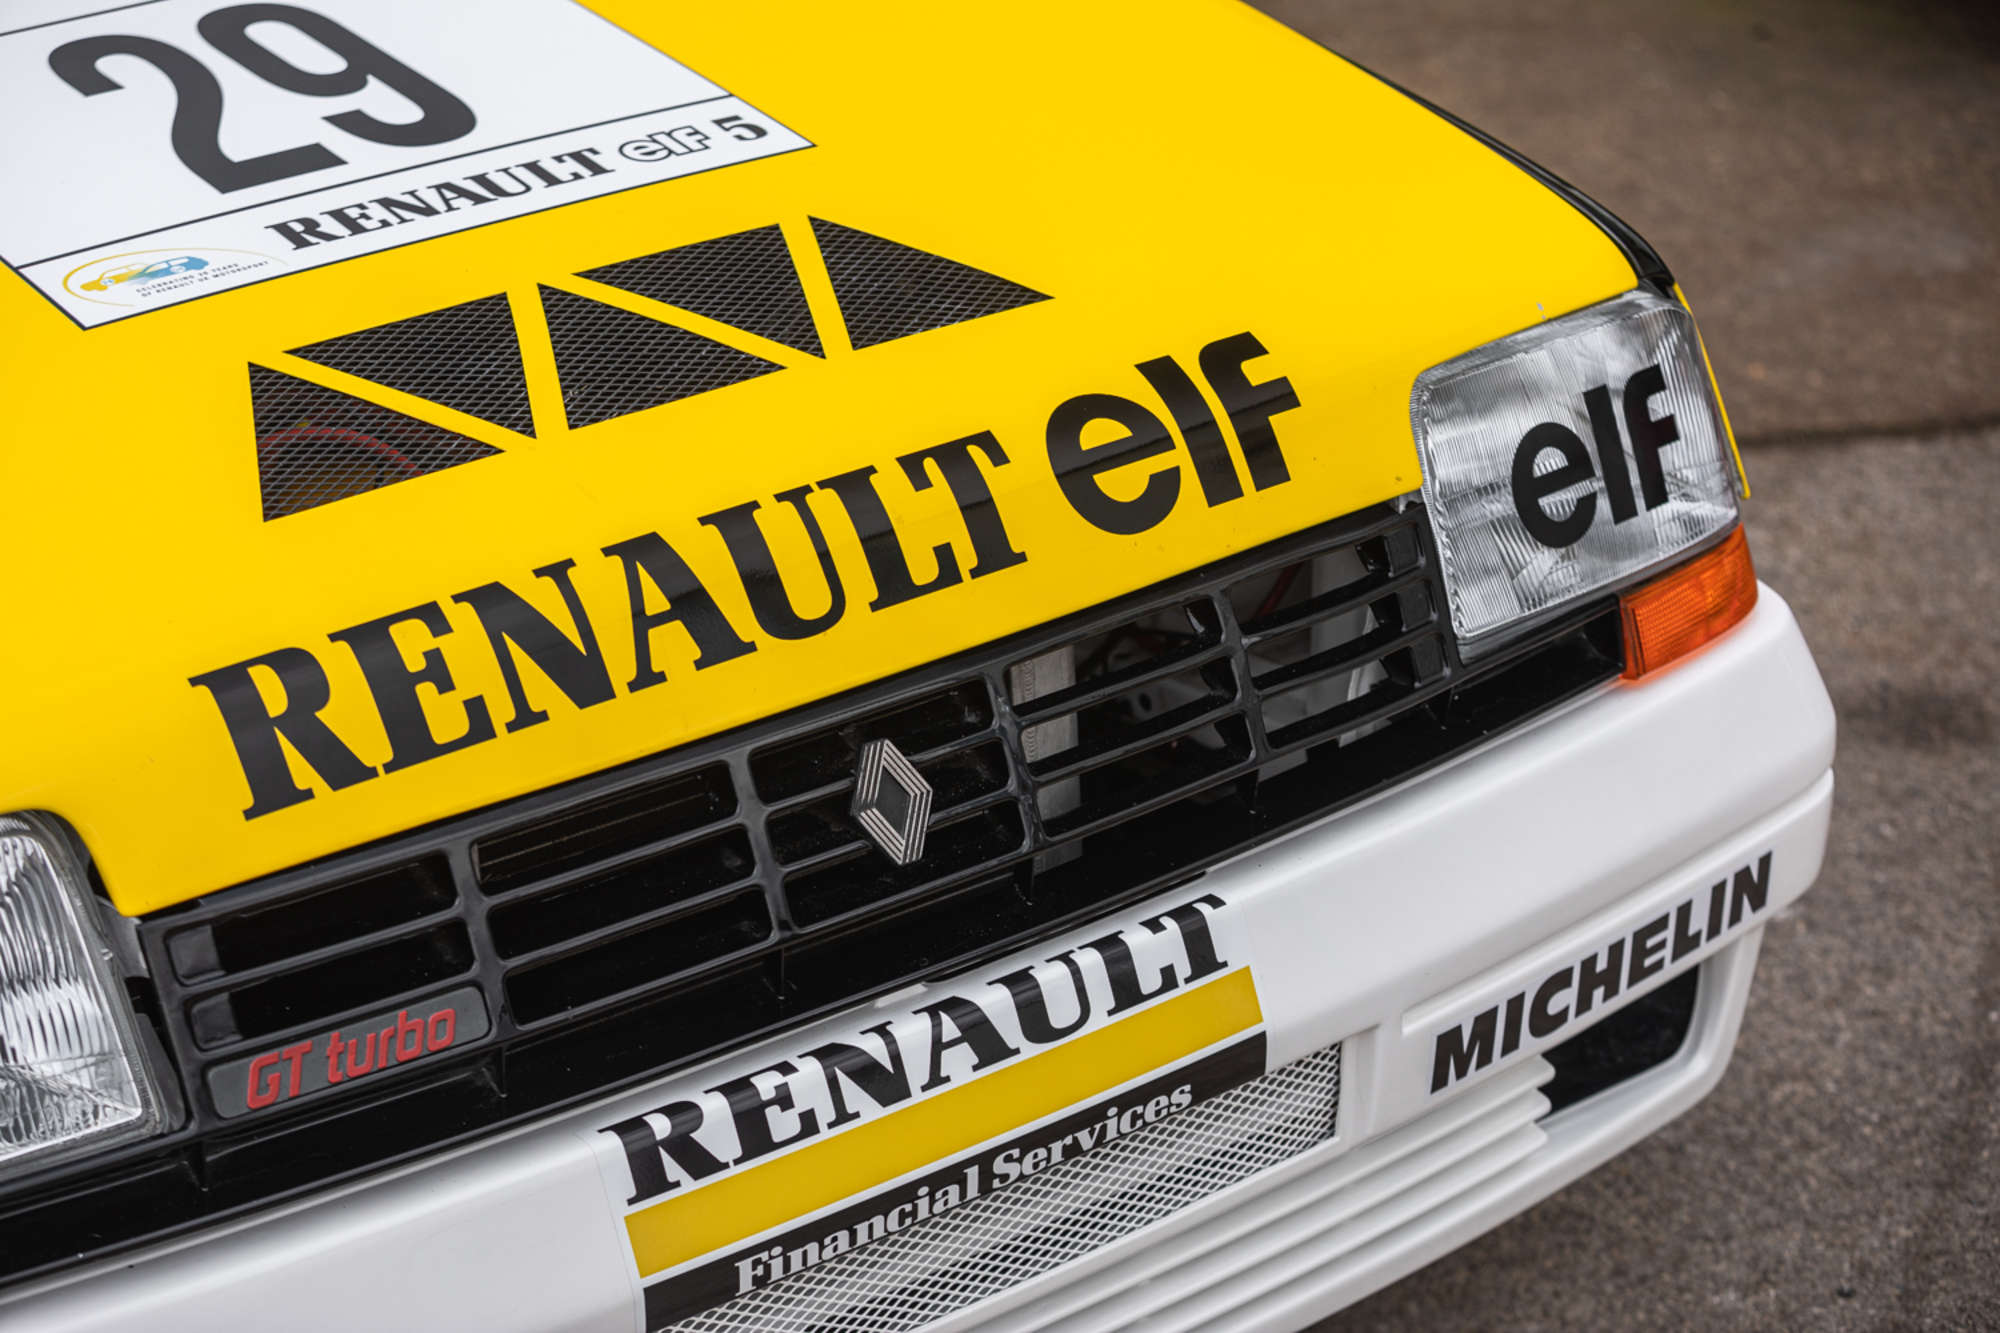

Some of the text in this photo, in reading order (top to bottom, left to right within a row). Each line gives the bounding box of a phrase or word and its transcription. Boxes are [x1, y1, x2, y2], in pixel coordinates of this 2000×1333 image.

[48, 3, 477, 194] 29
[264, 116, 769, 251] RENAULT elf 5
[1511, 363, 1681, 549] elf
[187, 331, 1301, 822] RENAULT elf
[246, 1007, 456, 1110] GT turbo
[598, 893, 1229, 1206] RENAULT
[1430, 850, 1773, 1095] MICHELIN
[734, 1083, 1193, 1297] Financial Services
